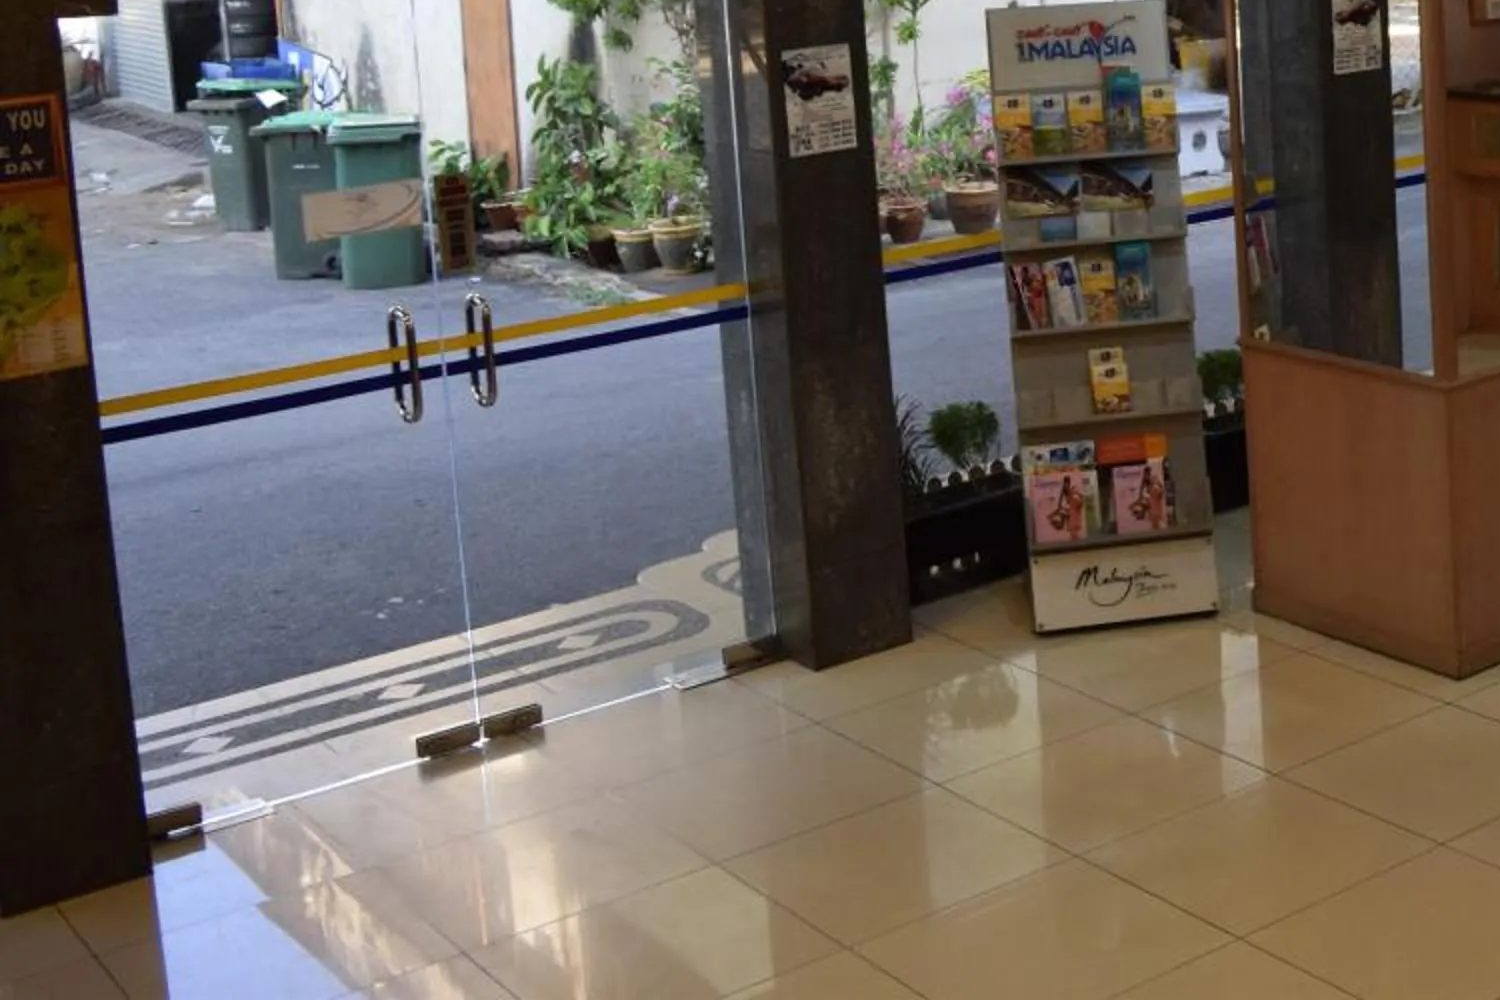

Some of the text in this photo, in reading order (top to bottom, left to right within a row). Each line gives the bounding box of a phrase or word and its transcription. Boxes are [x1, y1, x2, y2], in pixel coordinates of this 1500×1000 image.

[6, 108, 46, 132] YOU
[19, 141, 34, 156] A
[4, 158, 45, 175] DAY
